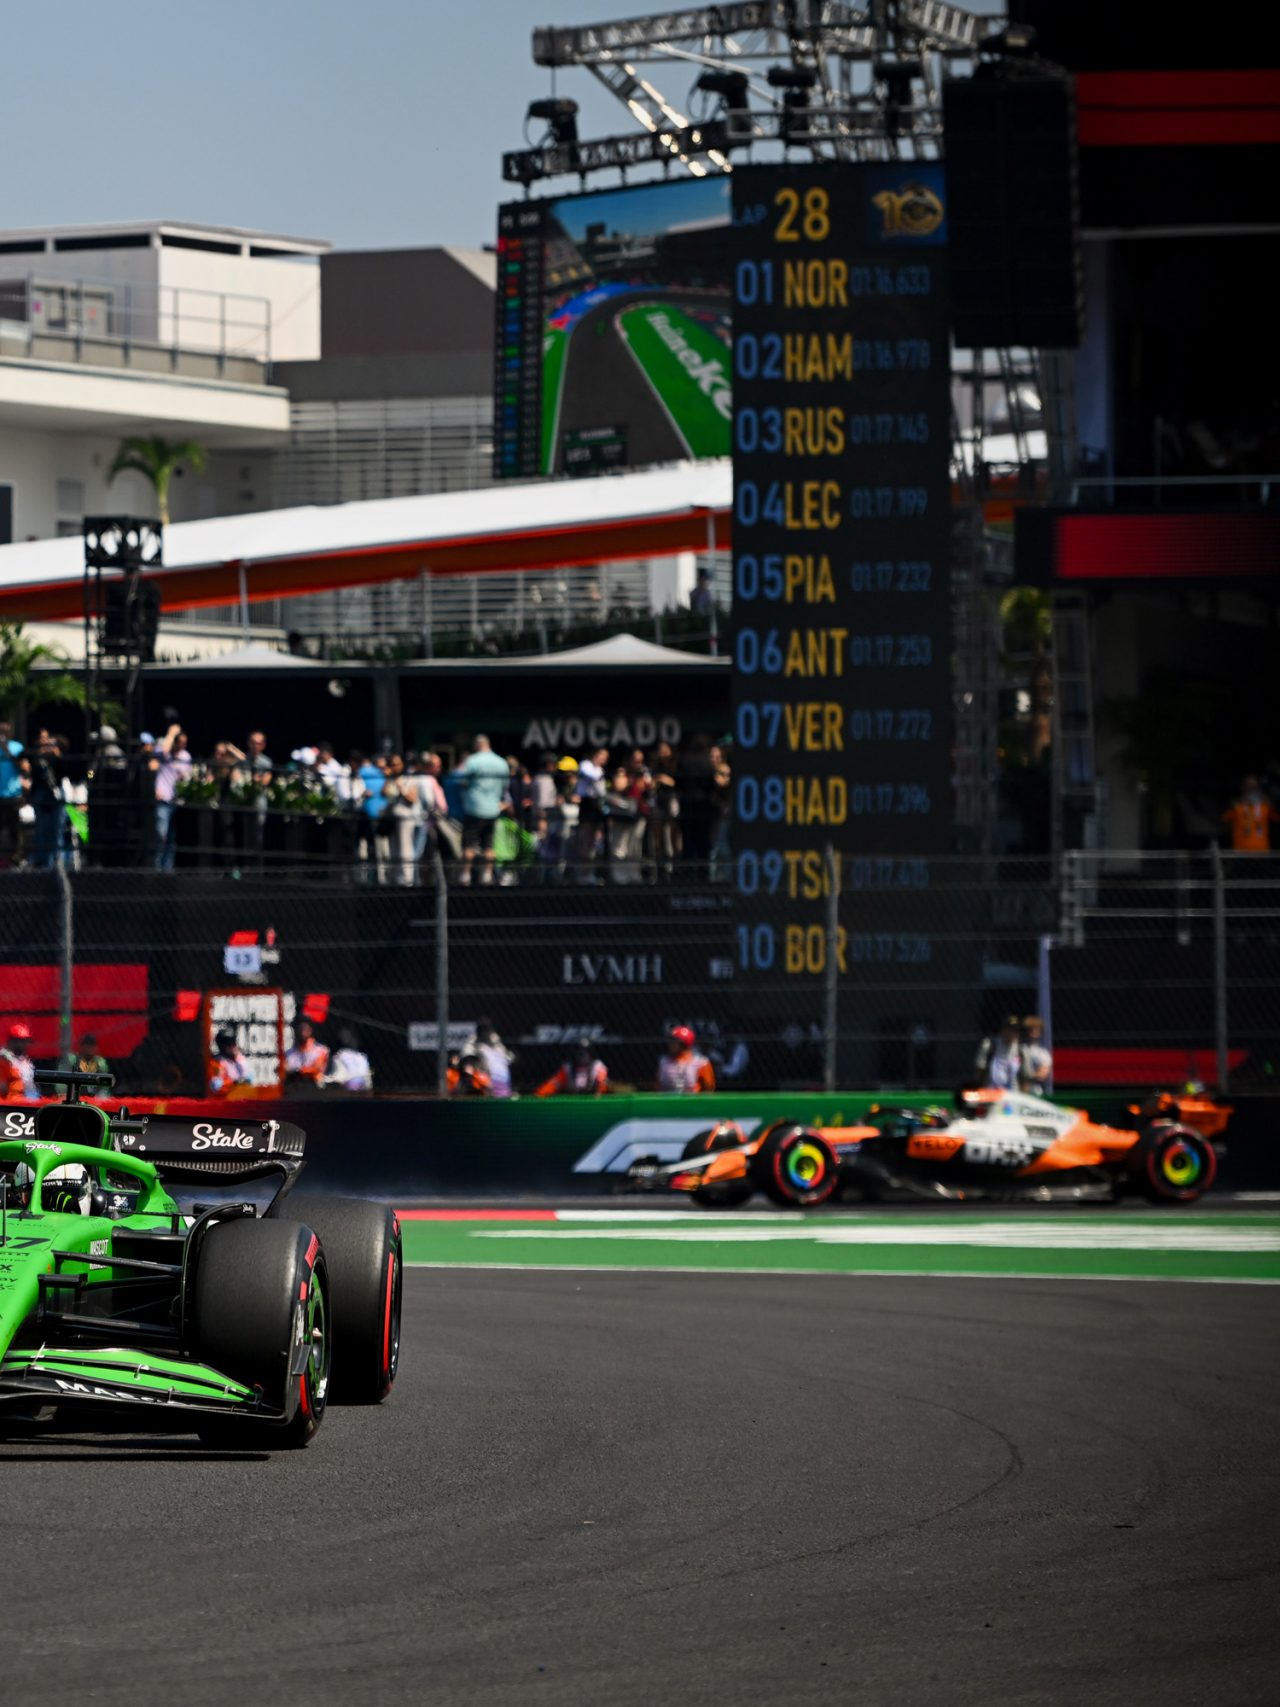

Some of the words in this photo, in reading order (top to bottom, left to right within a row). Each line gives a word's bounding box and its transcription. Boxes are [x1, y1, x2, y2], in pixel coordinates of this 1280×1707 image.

[776, 187, 830, 241] 28
[736, 260, 773, 306] 01
[785, 260, 848, 306] NOR
[736, 332, 783, 380] 02
[785, 335, 852, 380] HAM
[736, 407, 783, 453] 03
[785, 408, 845, 454] RUS
[736, 481, 784, 527] 04
[785, 481, 841, 528] LEC
[736, 554, 783, 600] 05
[785, 556, 836, 602] PIA
[736, 628, 783, 675] 06
[785, 628, 848, 676] ANT
[524, 716, 681, 749] AVOCADO
[736, 702, 782, 749] 07
[785, 703, 844, 751] VER
[736, 776, 784, 822] 08
[785, 777, 848, 825] HAD
[737, 849, 783, 896] 09
[563, 954, 662, 984] LVMH
[737, 924, 775, 970] 10
[24, 1141, 63, 1157] Stake
[191, 1123, 254, 1150] Stake
